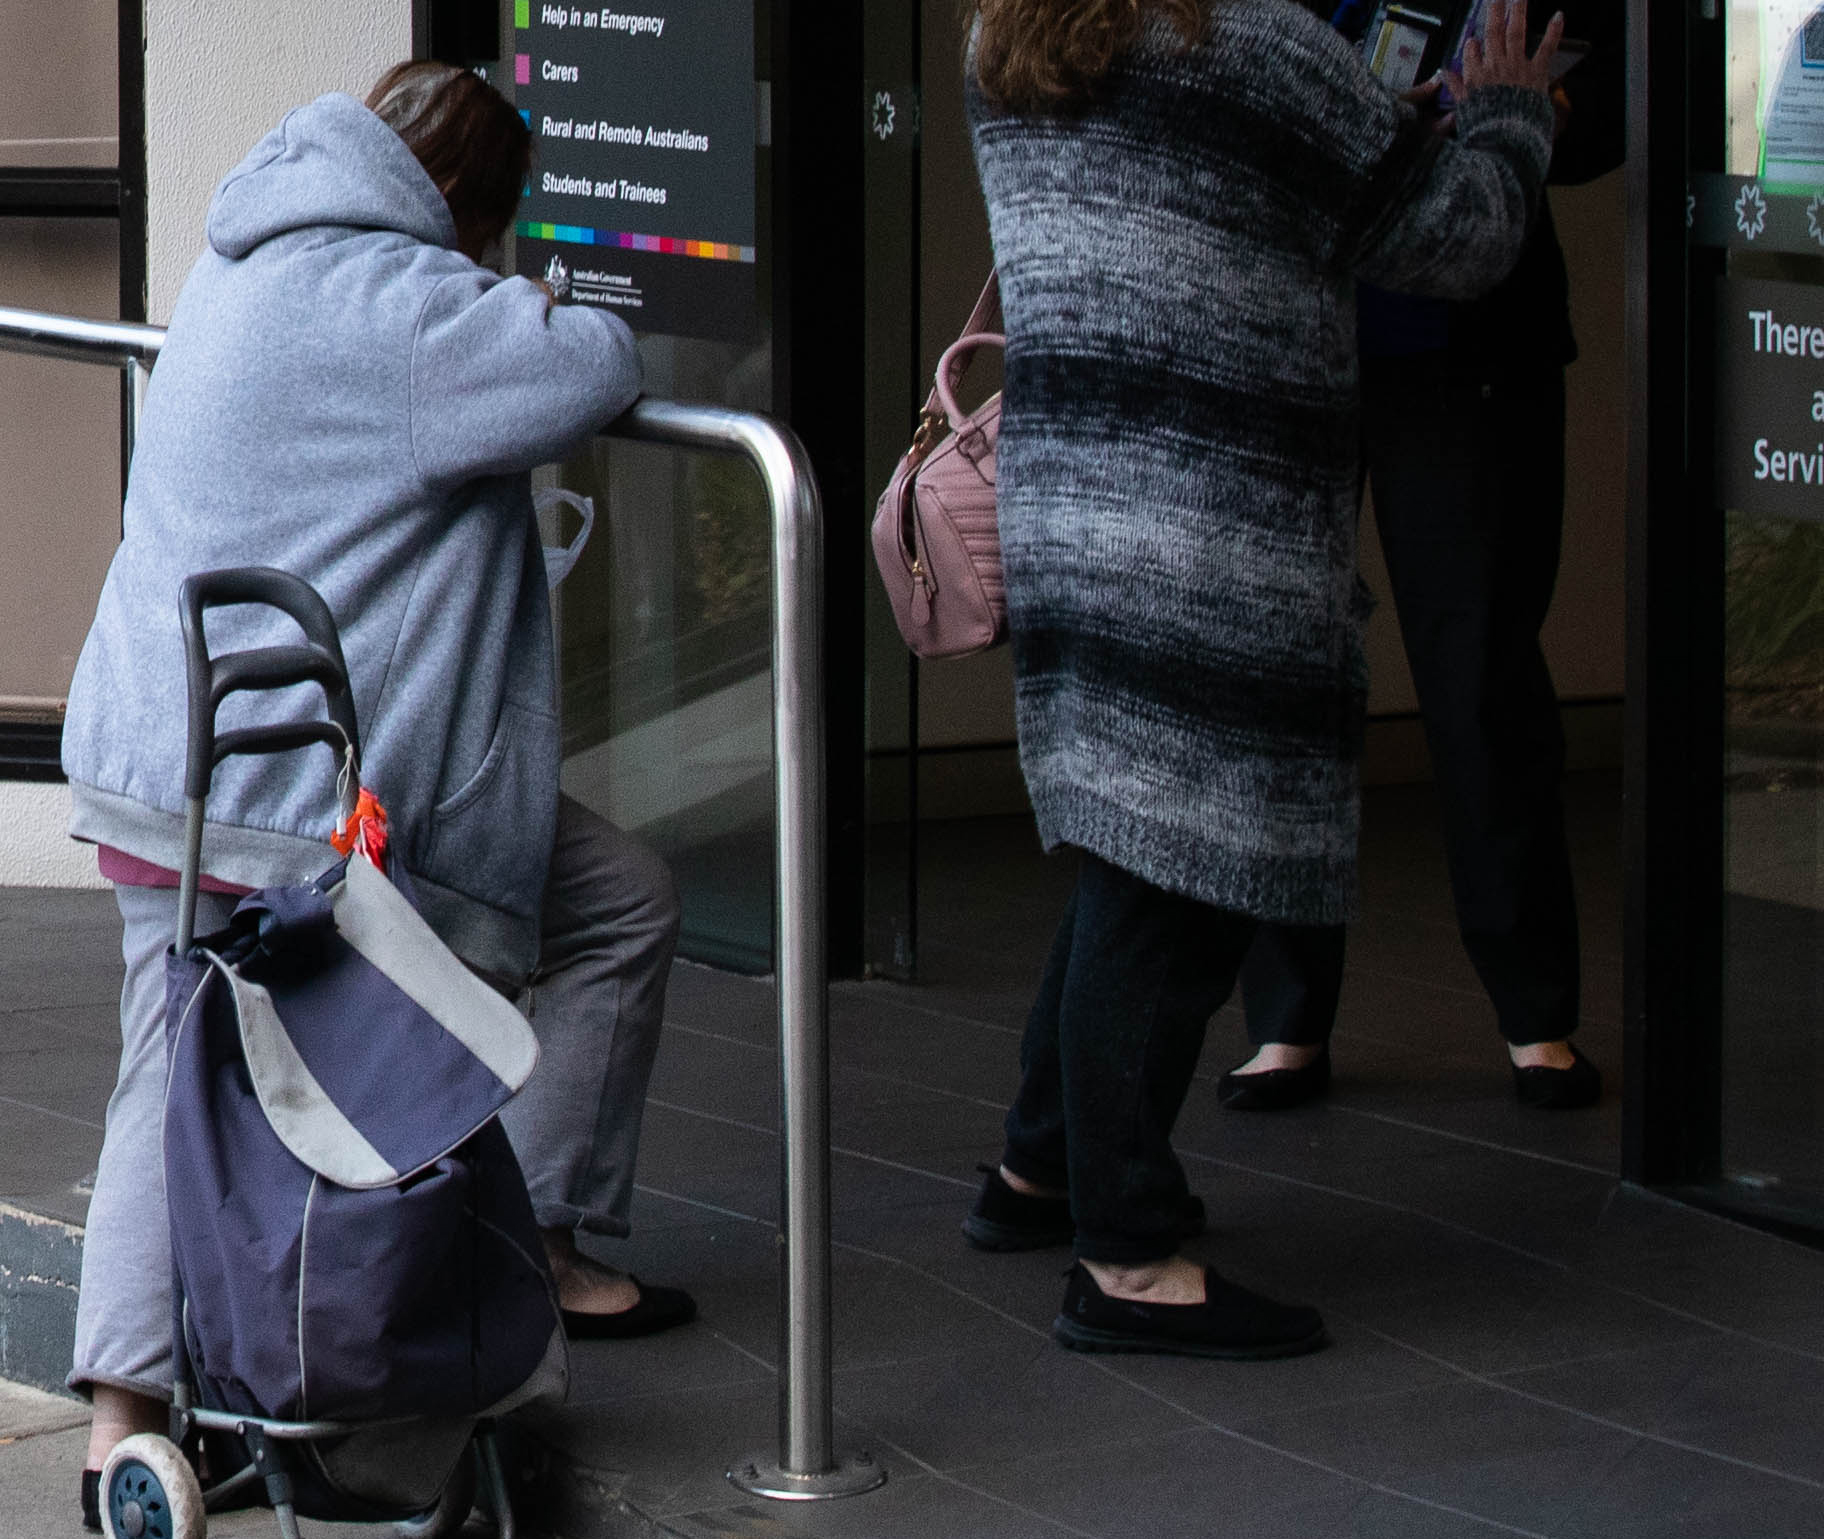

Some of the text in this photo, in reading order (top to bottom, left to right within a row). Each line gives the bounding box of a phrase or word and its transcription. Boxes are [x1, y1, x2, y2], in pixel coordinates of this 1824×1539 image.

[542, 5, 664, 37] Help in an Emergency
[542, 61, 578, 82] Carers
[542, 116, 708, 151] Rural and Remote Australians
[542, 172, 666, 204] Students and Trainees
[1749, 310, 1824, 359] There
[1754, 438, 1824, 485] Servi
